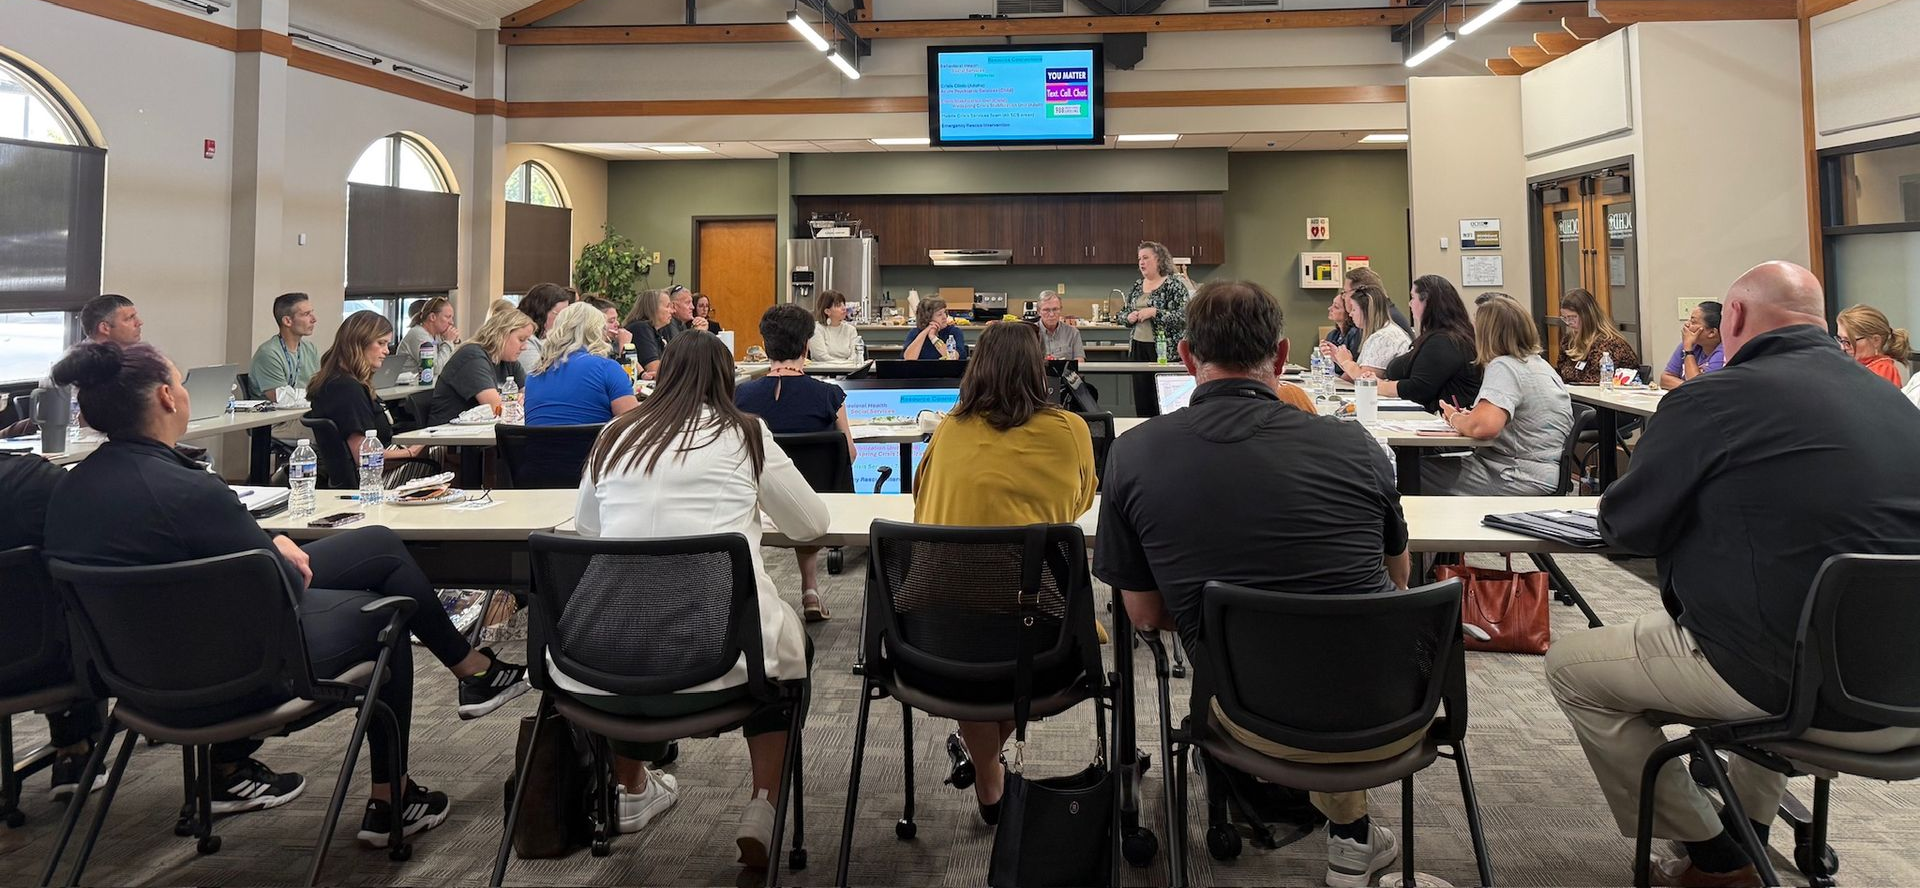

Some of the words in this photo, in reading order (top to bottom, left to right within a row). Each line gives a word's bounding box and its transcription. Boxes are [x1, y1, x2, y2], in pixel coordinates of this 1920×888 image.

[1047, 71, 1061, 80] YOU
[1062, 71, 1087, 79] MATTER
[1047, 89, 1060, 97] Text.
[1060, 88, 1073, 97] Call.
[1073, 88, 1087, 97] Chat.
